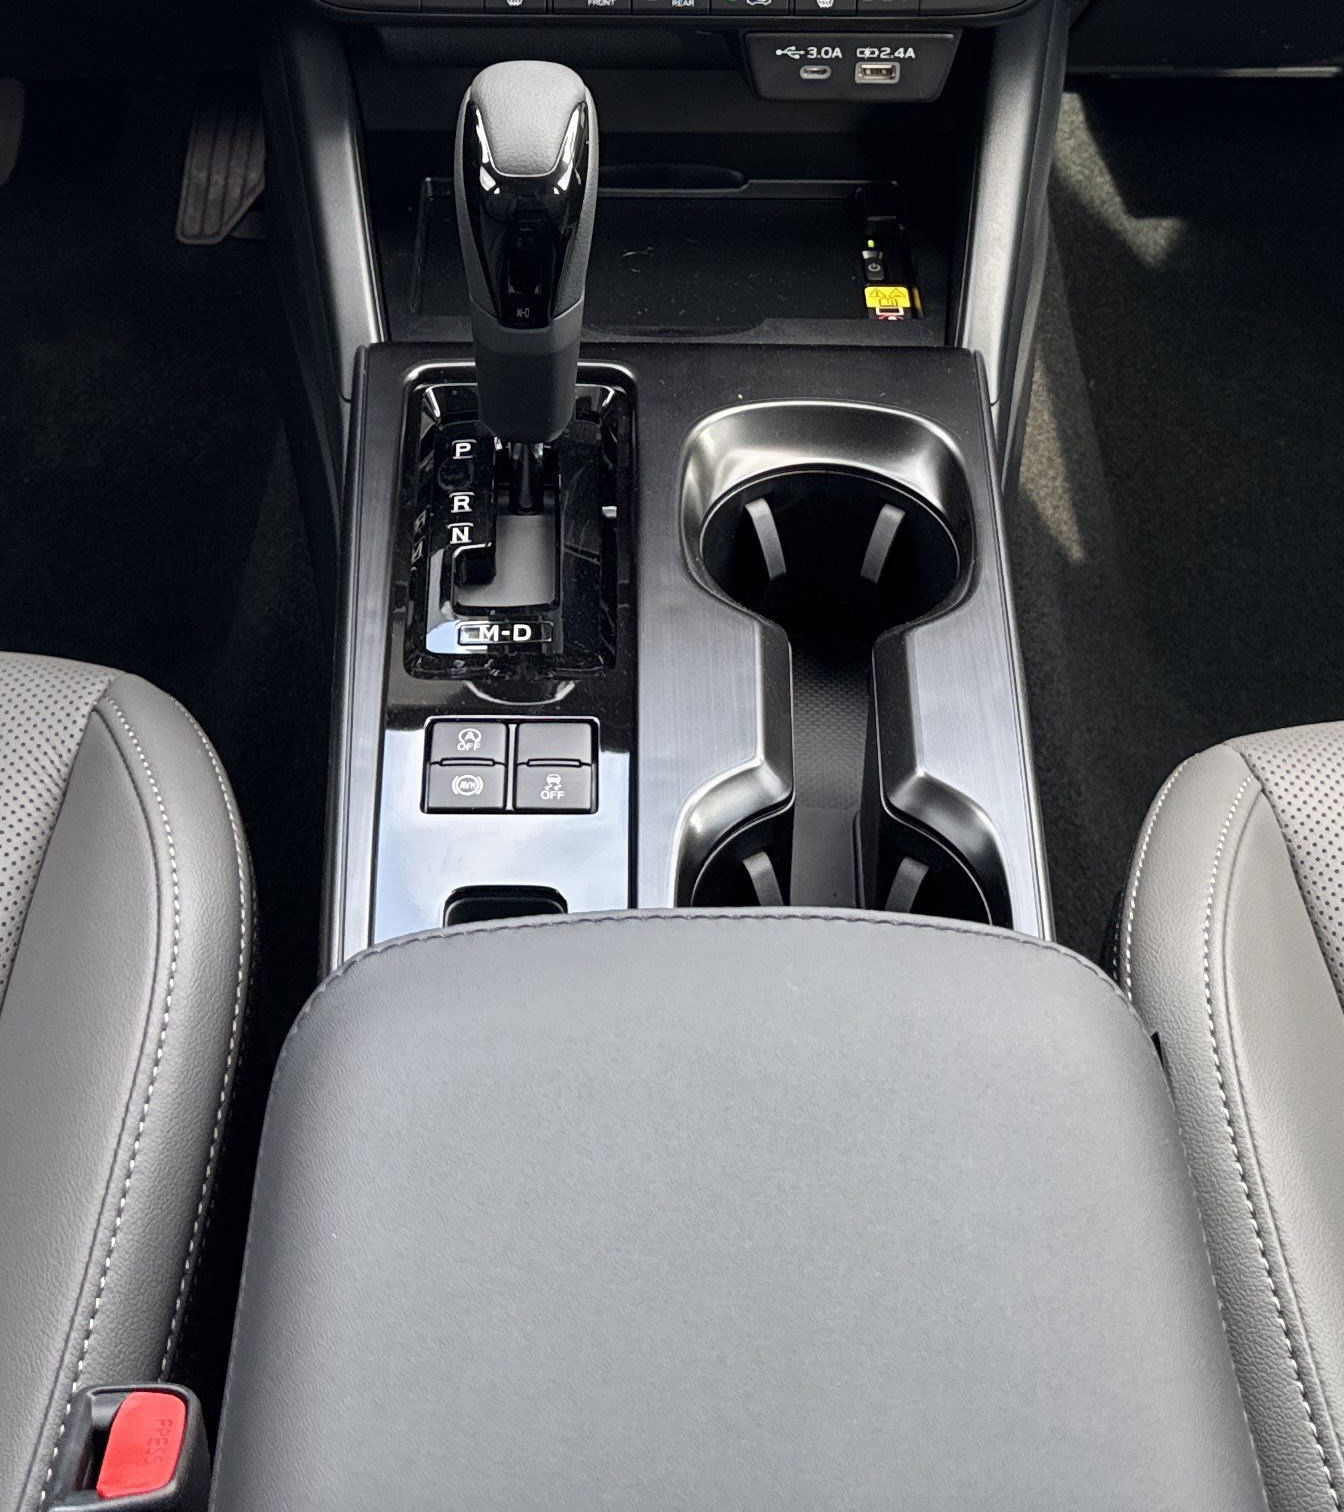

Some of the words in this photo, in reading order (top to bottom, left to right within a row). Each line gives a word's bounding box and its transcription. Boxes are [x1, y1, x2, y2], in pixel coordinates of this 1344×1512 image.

[807, 46, 842, 59] 3.0A
[880, 47, 916, 59] 2.4A
[456, 443, 471, 457] P
[453, 496, 471, 511] R
[452, 527, 469, 542] N
[457, 743, 481, 751] OFF
[541, 791, 565, 799] OFF
